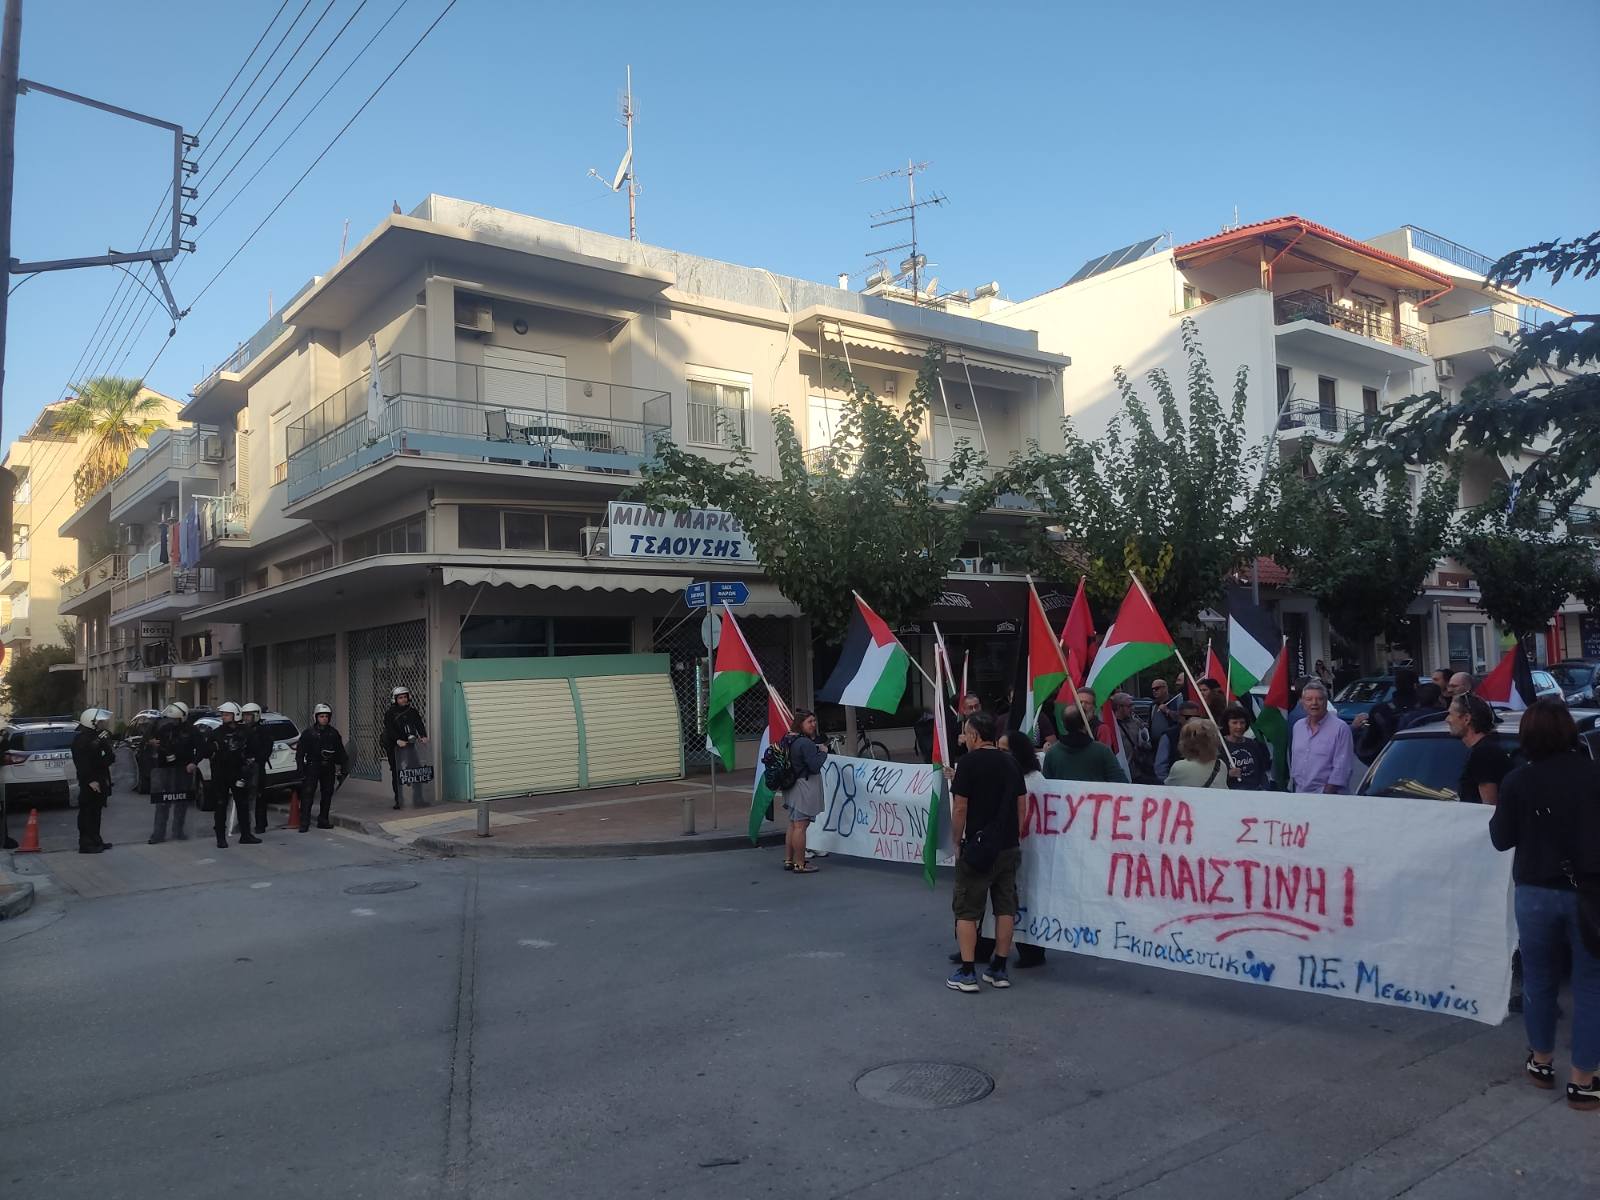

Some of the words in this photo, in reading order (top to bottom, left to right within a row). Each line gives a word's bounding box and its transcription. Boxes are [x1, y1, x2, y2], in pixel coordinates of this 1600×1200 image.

[613, 506, 667, 528] ΜΙΝΙ
[673, 510, 742, 533] ΜΑΡΚΕ
[629, 534, 742, 558] ΤΣΑΟΥΣΗΣ
[400, 775, 432, 785] POLICE
[866, 765, 903, 796] 1940
[163, 792, 187, 801] POLICE
[1236, 817, 1310, 849] ΣΤΗΝ
